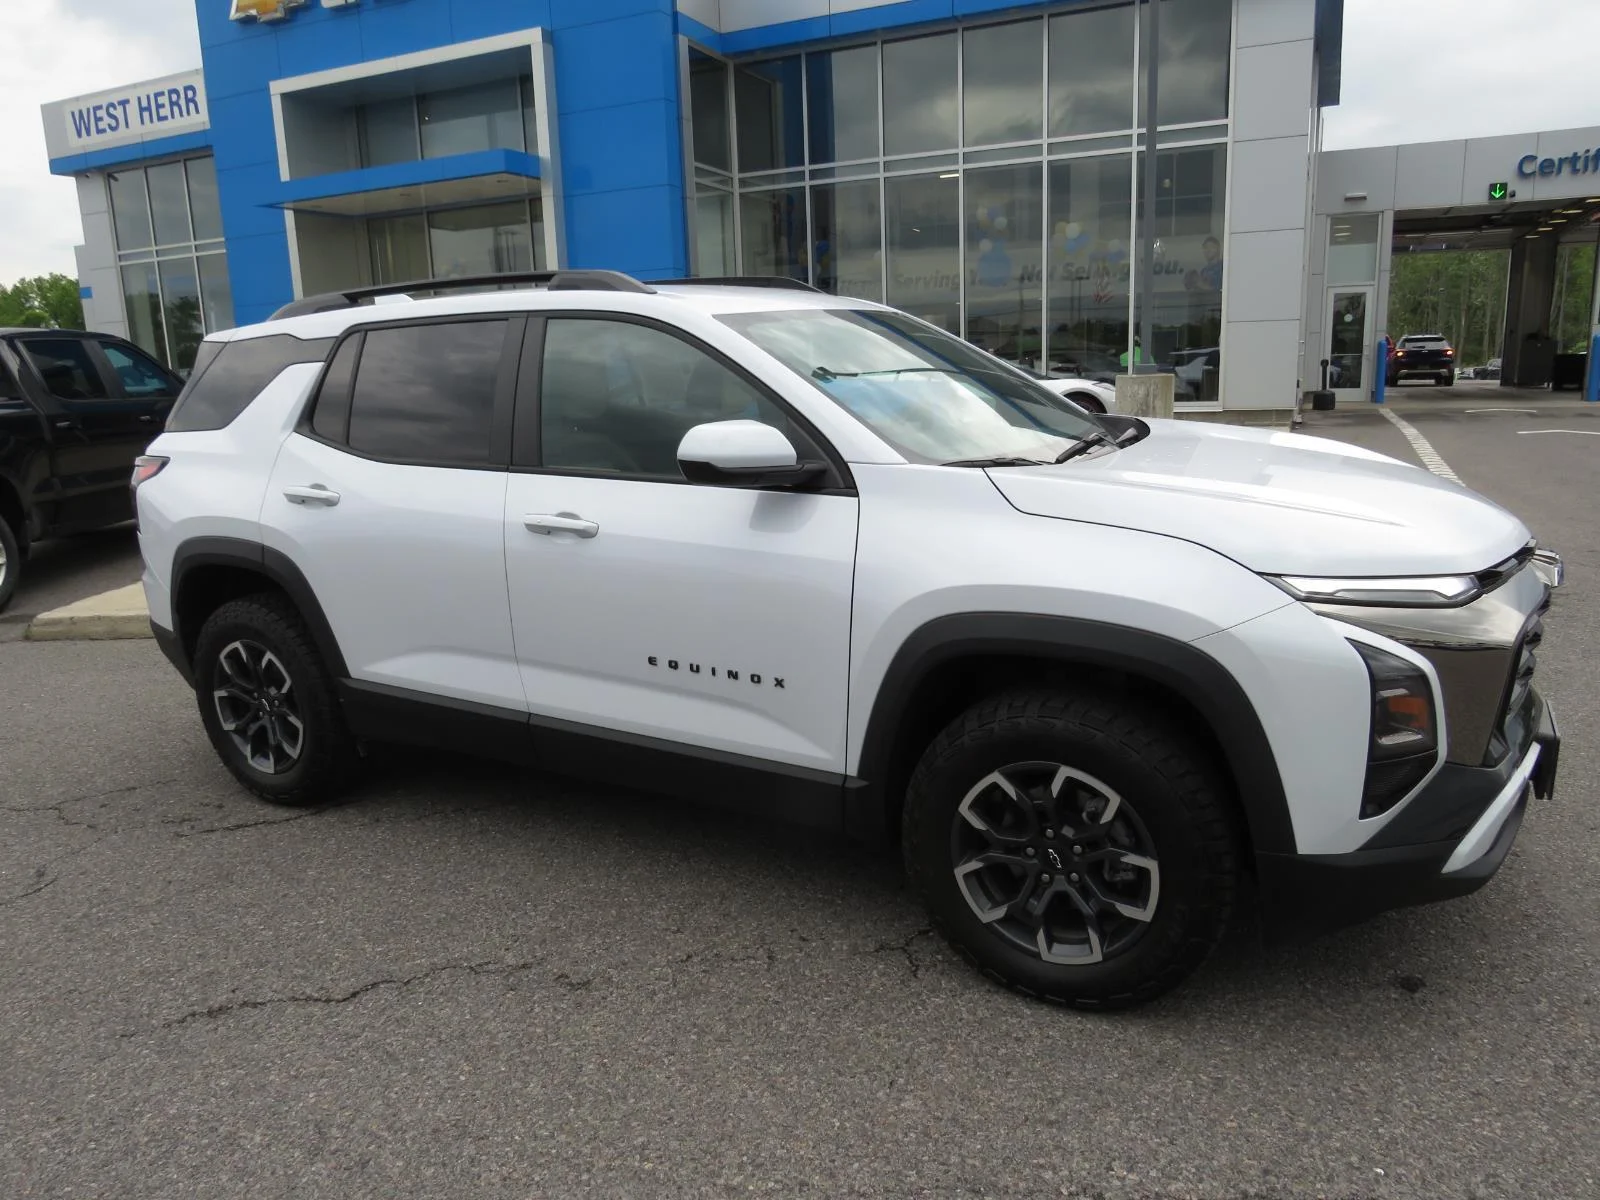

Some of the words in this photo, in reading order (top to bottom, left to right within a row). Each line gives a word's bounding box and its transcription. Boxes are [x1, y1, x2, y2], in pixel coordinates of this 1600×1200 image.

[71, 99, 131, 138] WEST
[138, 84, 201, 126] HERR
[647, 655, 786, 689] EQUINOX
